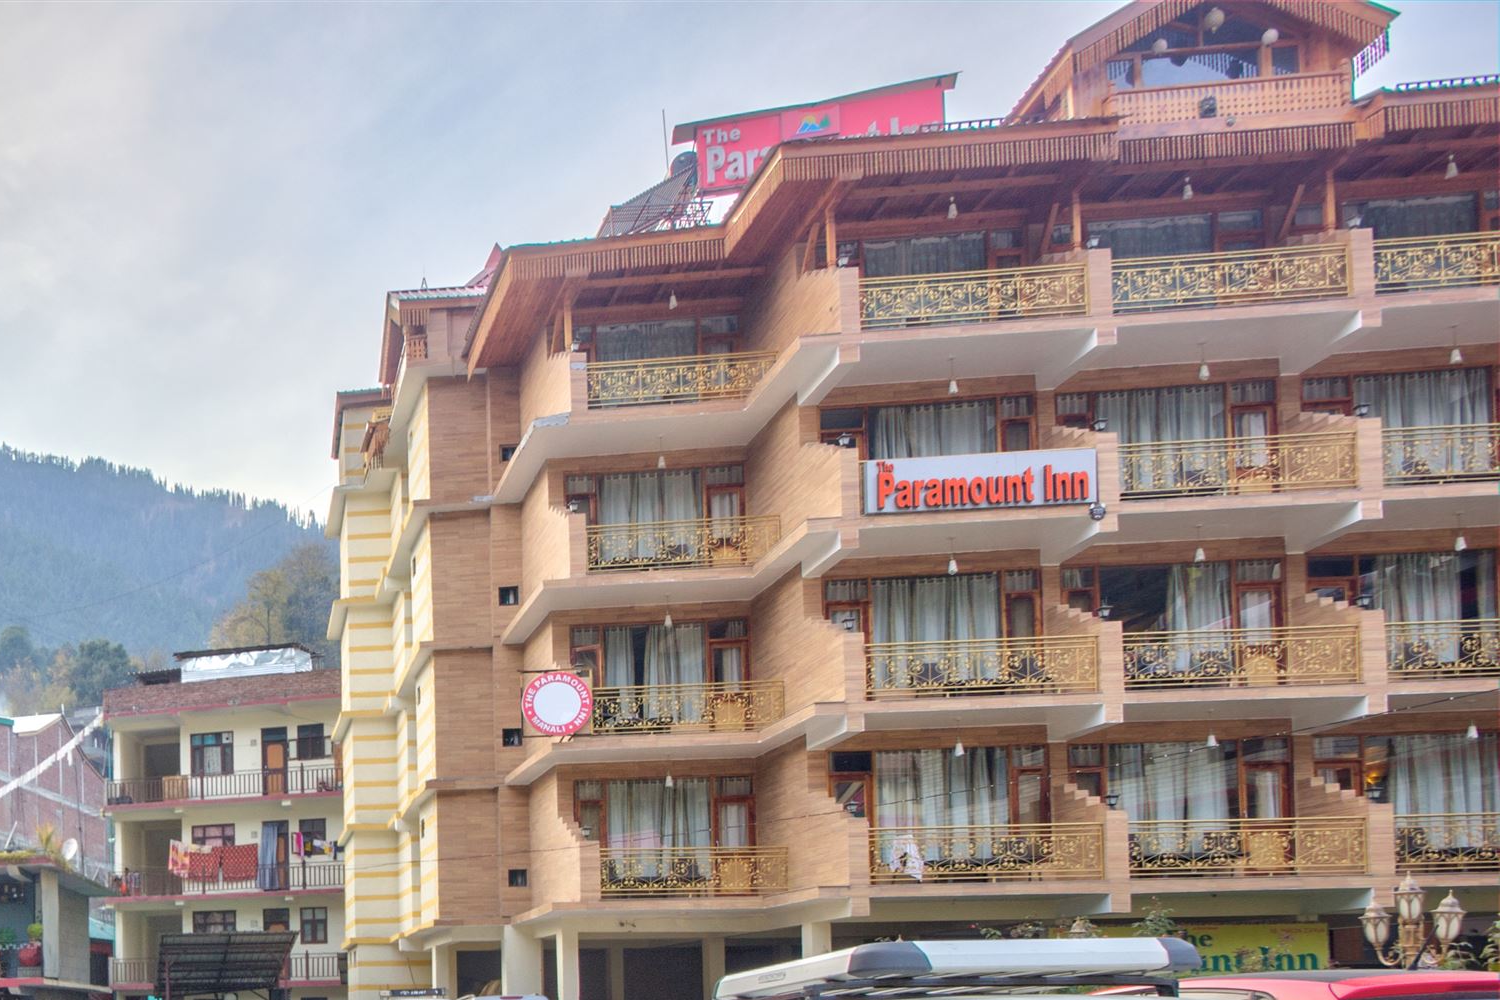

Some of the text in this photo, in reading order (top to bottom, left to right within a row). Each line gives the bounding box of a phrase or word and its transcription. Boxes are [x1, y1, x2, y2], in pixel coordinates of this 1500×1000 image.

[702, 127, 741, 145] The
[876, 461, 894, 474] The
[876, 464, 1090, 510] Paramount Inn
[525, 674, 590, 726] THE PARAMOUNT INN
[532, 716, 566, 733] MANALI
